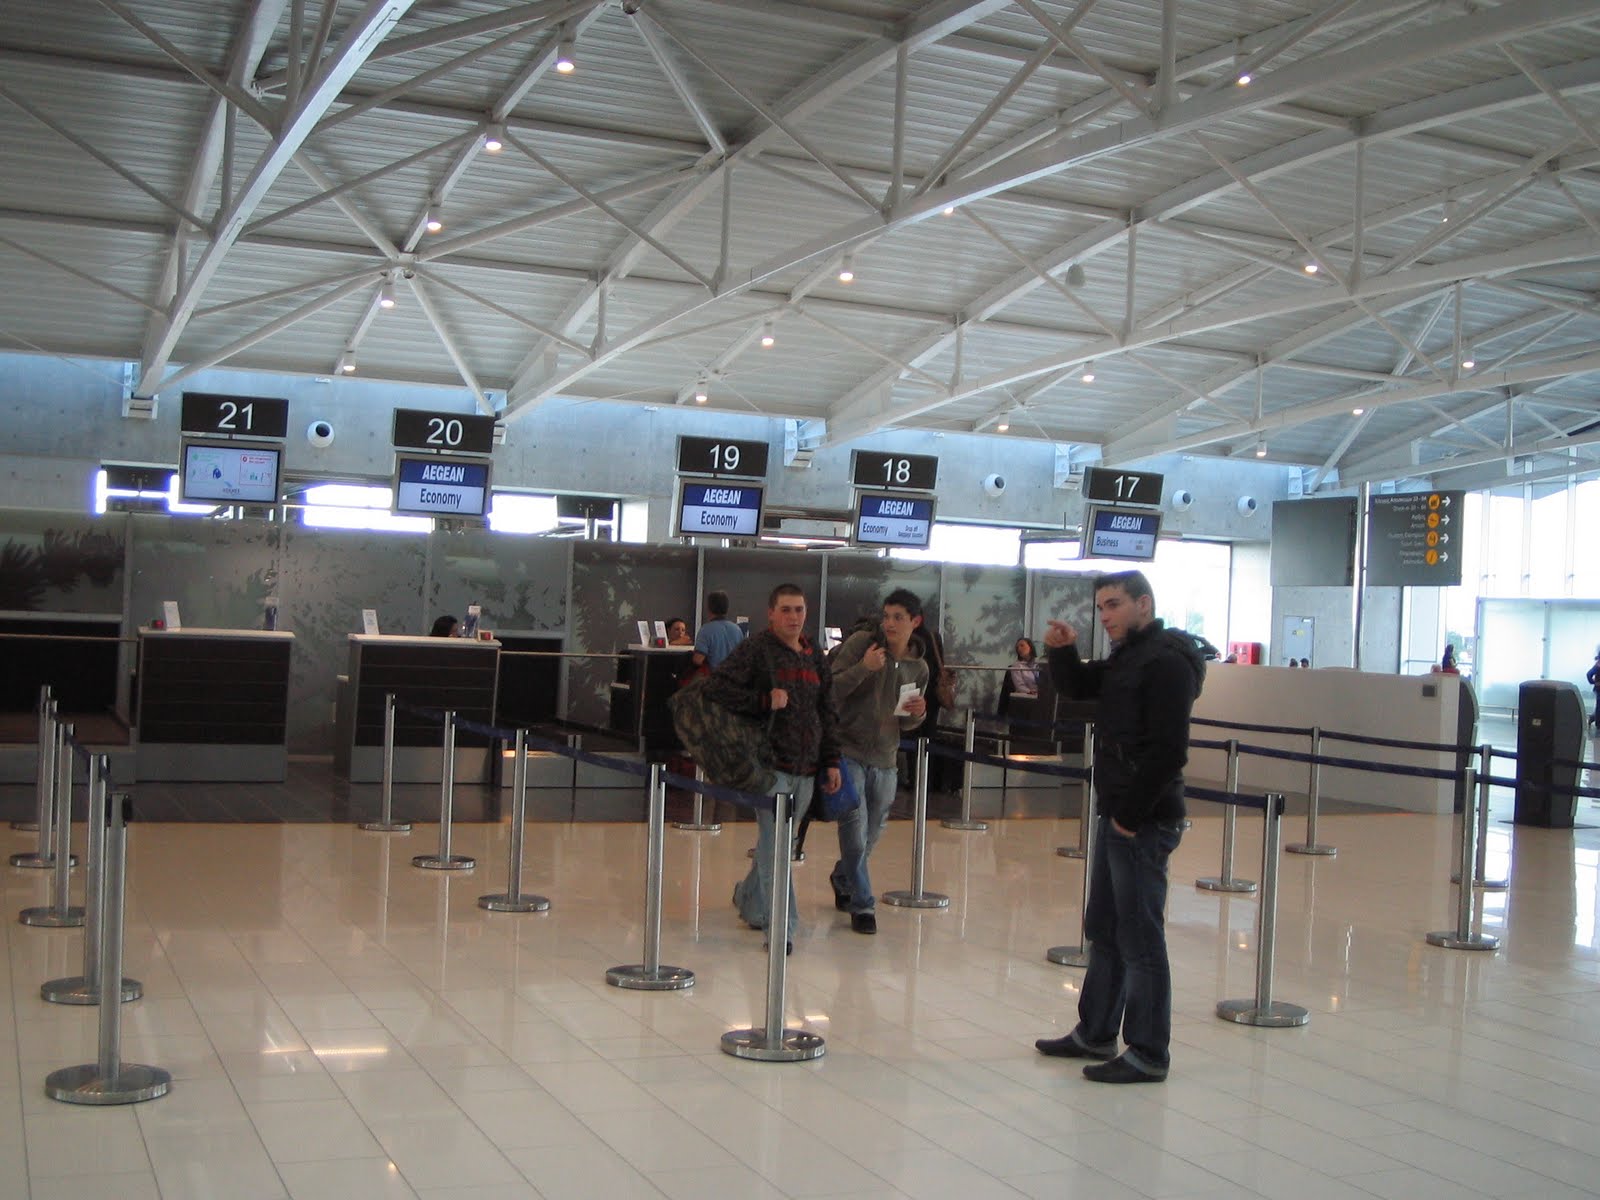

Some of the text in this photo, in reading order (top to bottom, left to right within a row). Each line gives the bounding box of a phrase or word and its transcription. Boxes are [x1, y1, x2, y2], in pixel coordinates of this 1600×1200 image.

[218, 402, 254, 429] 21
[426, 418, 463, 446] 20
[709, 444, 740, 470] 19
[422, 464, 465, 482] AEGEAN
[882, 459, 911, 483] 18
[1115, 475, 1141, 498] 17
[420, 488, 462, 509] Economy
[703, 489, 741, 505] AEGEAN
[878, 500, 914, 516] AEGEAN
[701, 511, 738, 530] Economy
[862, 522, 888, 536] Economy
[1111, 516, 1142, 530] AEGEAN
[1096, 536, 1119, 548] Business
